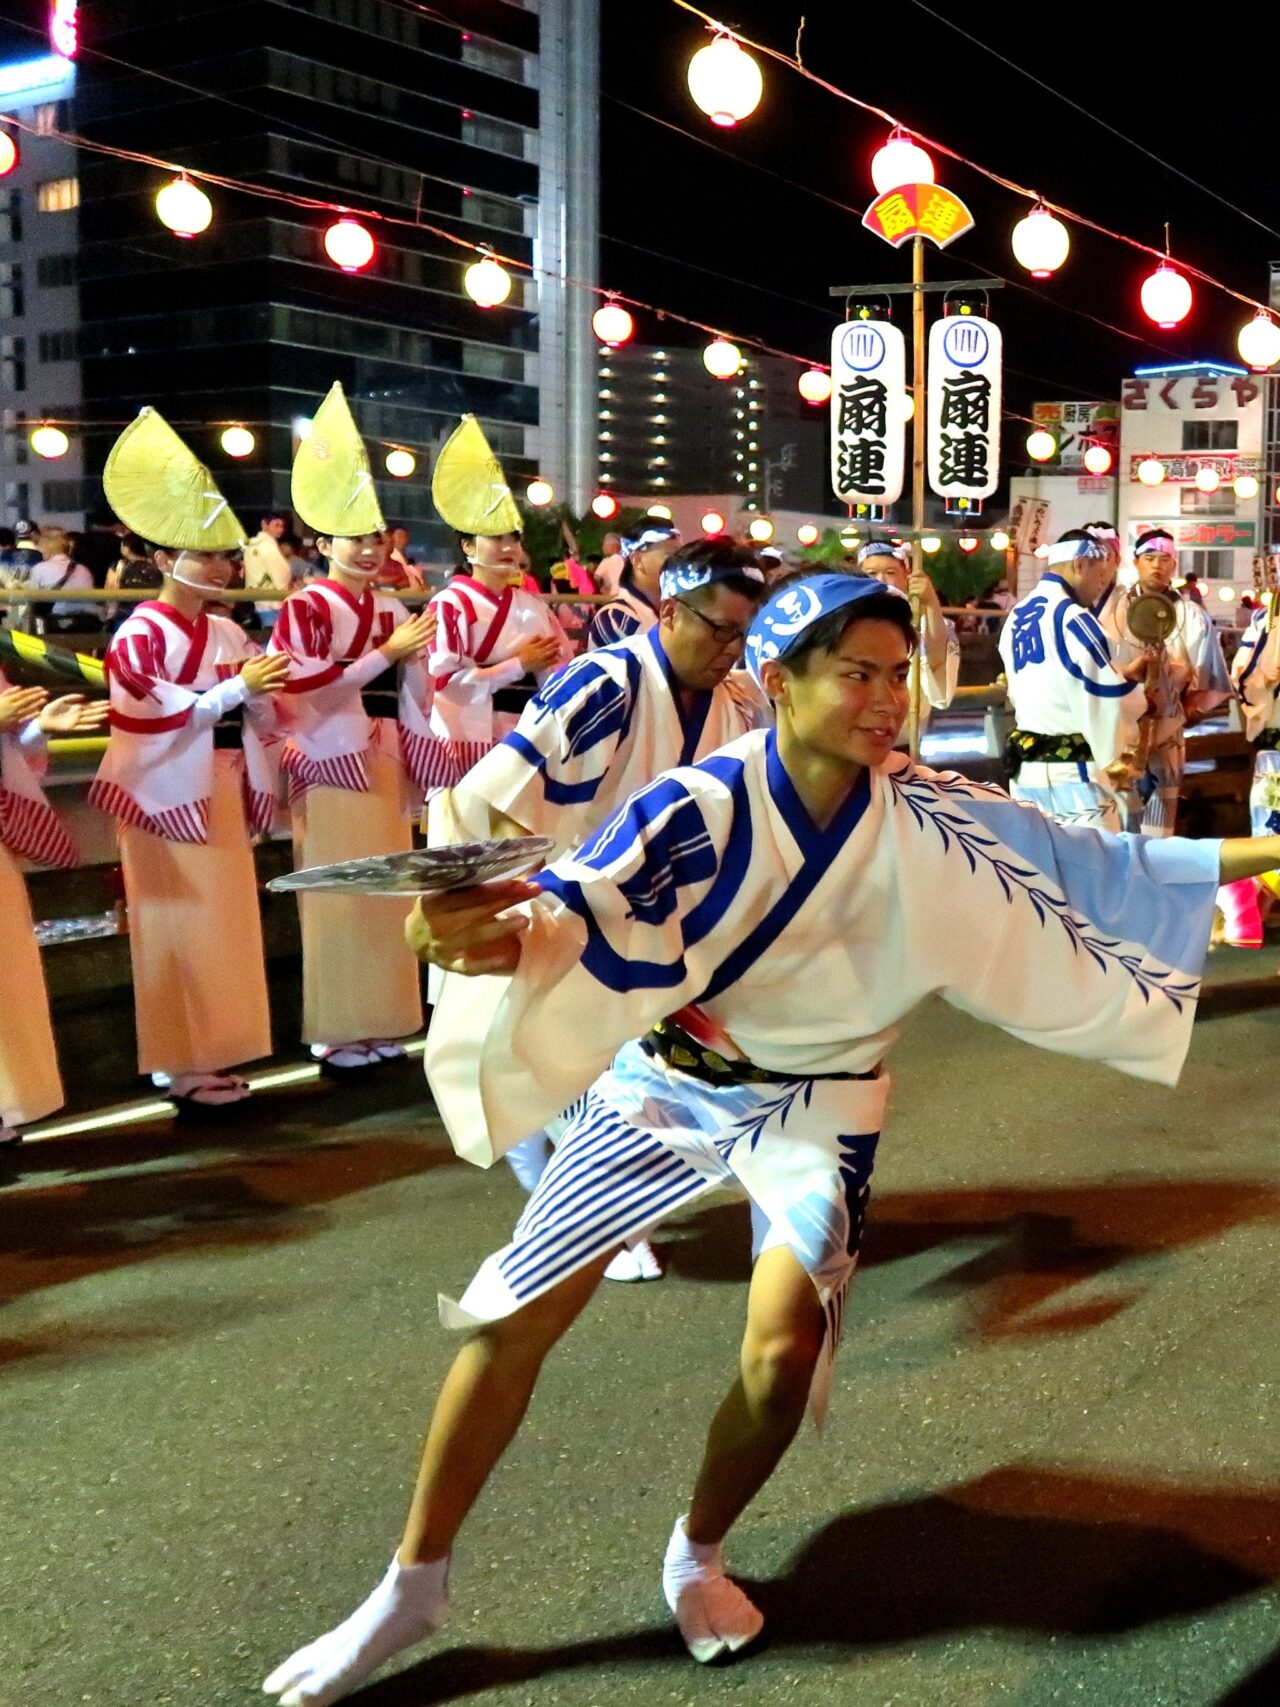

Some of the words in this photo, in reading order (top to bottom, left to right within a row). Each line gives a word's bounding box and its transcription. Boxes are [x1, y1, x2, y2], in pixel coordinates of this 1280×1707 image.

[874, 192, 960, 240] 扇連
[838, 375, 888, 495] 扇連
[938, 370, 992, 488] 扇連
[1123, 378, 1259, 410] さくらや
